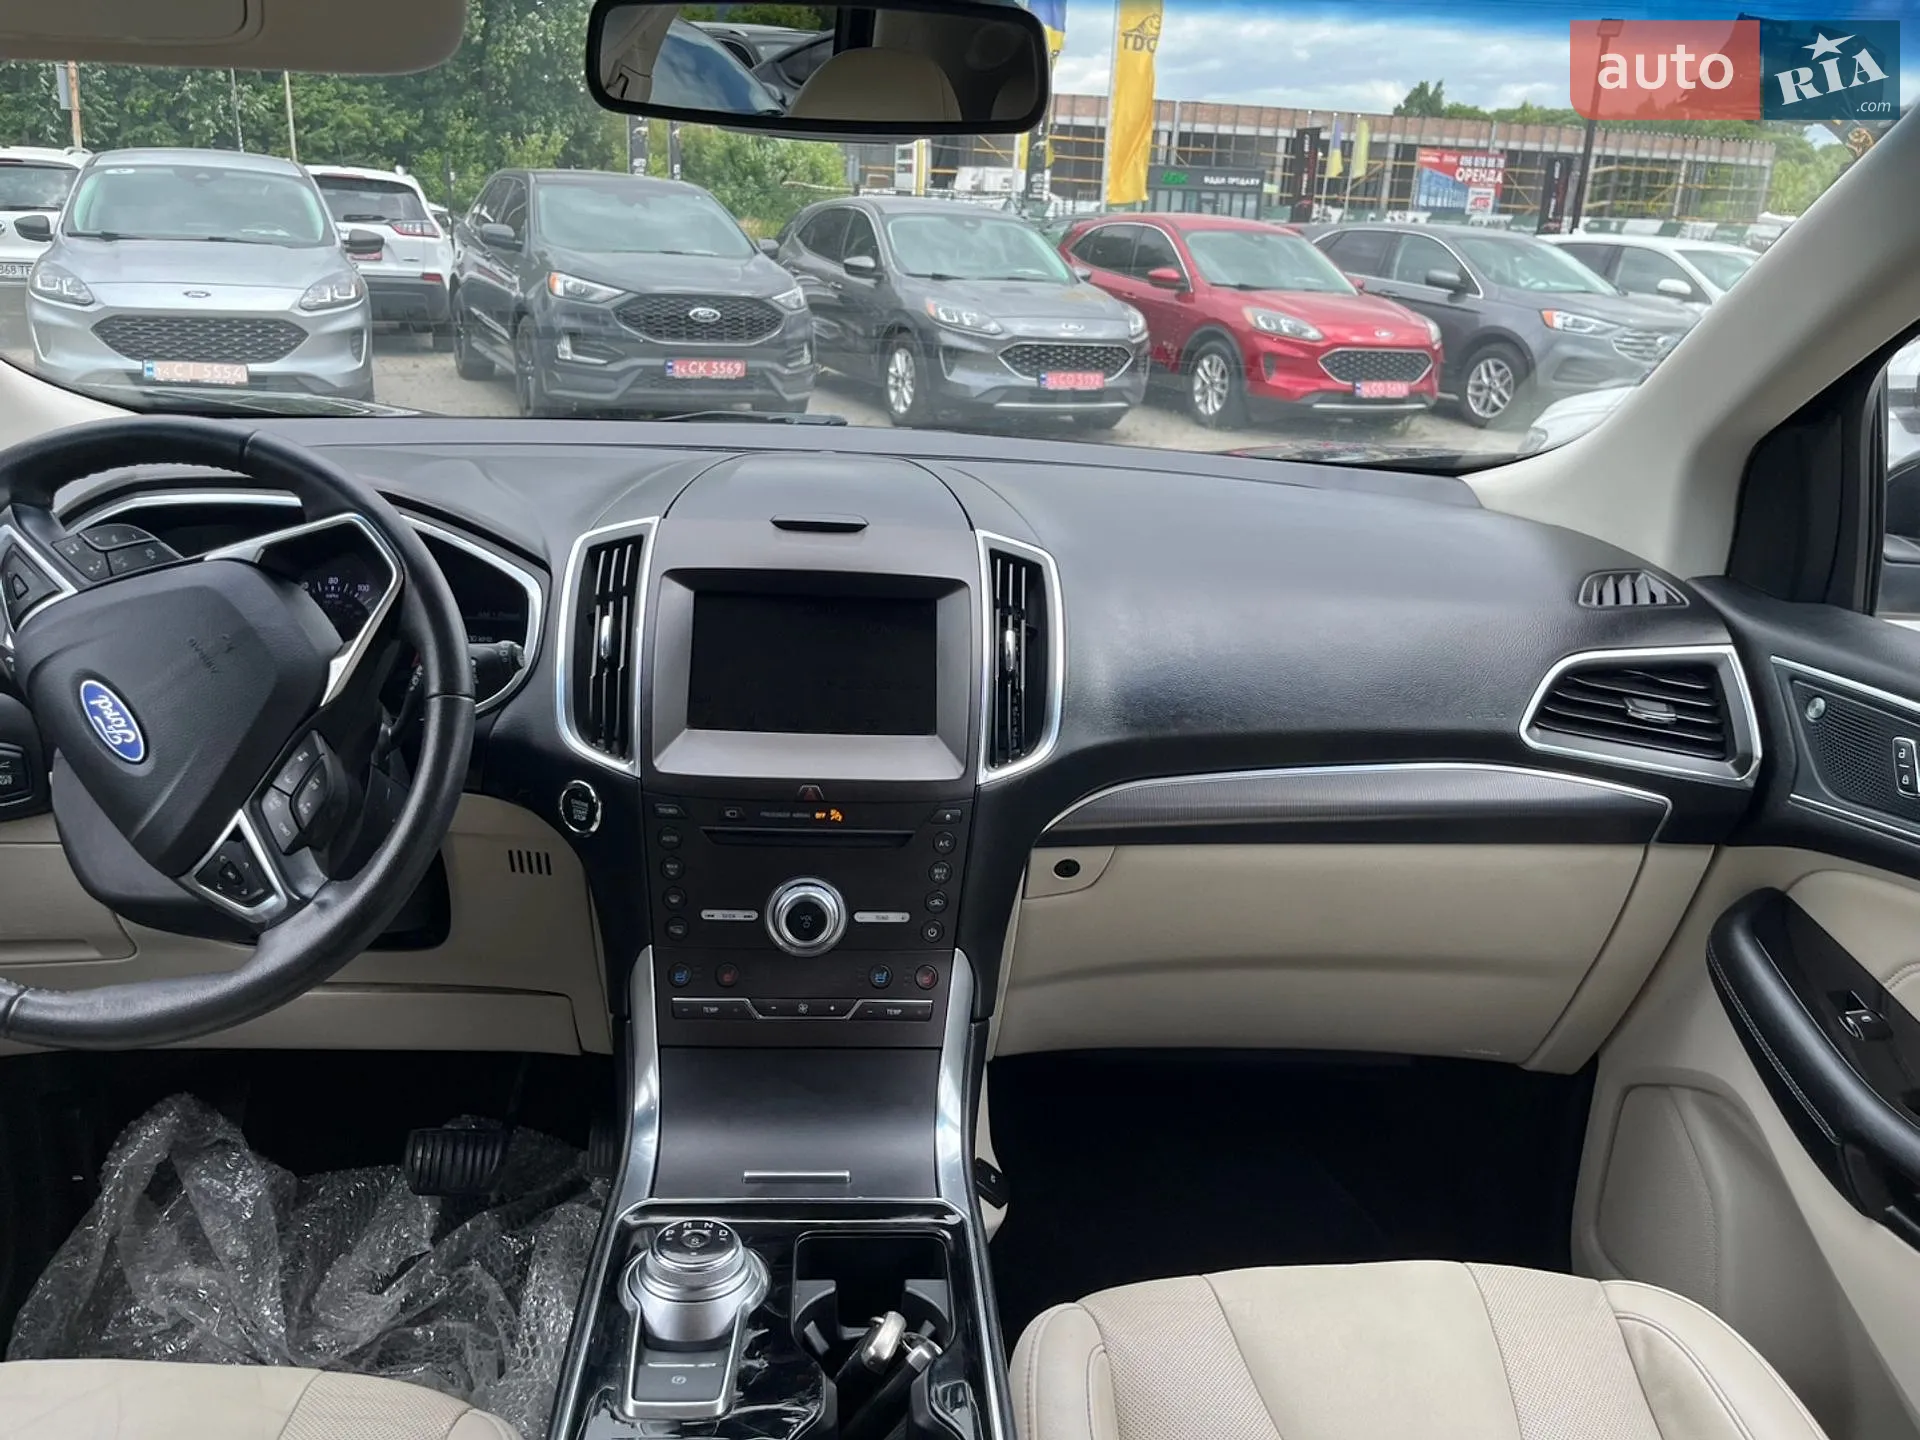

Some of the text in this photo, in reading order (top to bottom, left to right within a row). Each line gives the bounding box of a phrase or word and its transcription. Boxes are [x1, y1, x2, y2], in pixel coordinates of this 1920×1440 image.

[1455, 166, 1503, 184] ОРЕНДА
[711, 361, 742, 375] 5569
[328, 576, 339, 585] 80
[357, 584, 370, 592] 100
[814, 811, 827, 819] OFF
[938, 839, 951, 847] A/C
[702, 1006, 719, 1014] TEMP
[886, 1008, 903, 1016] TEMP
